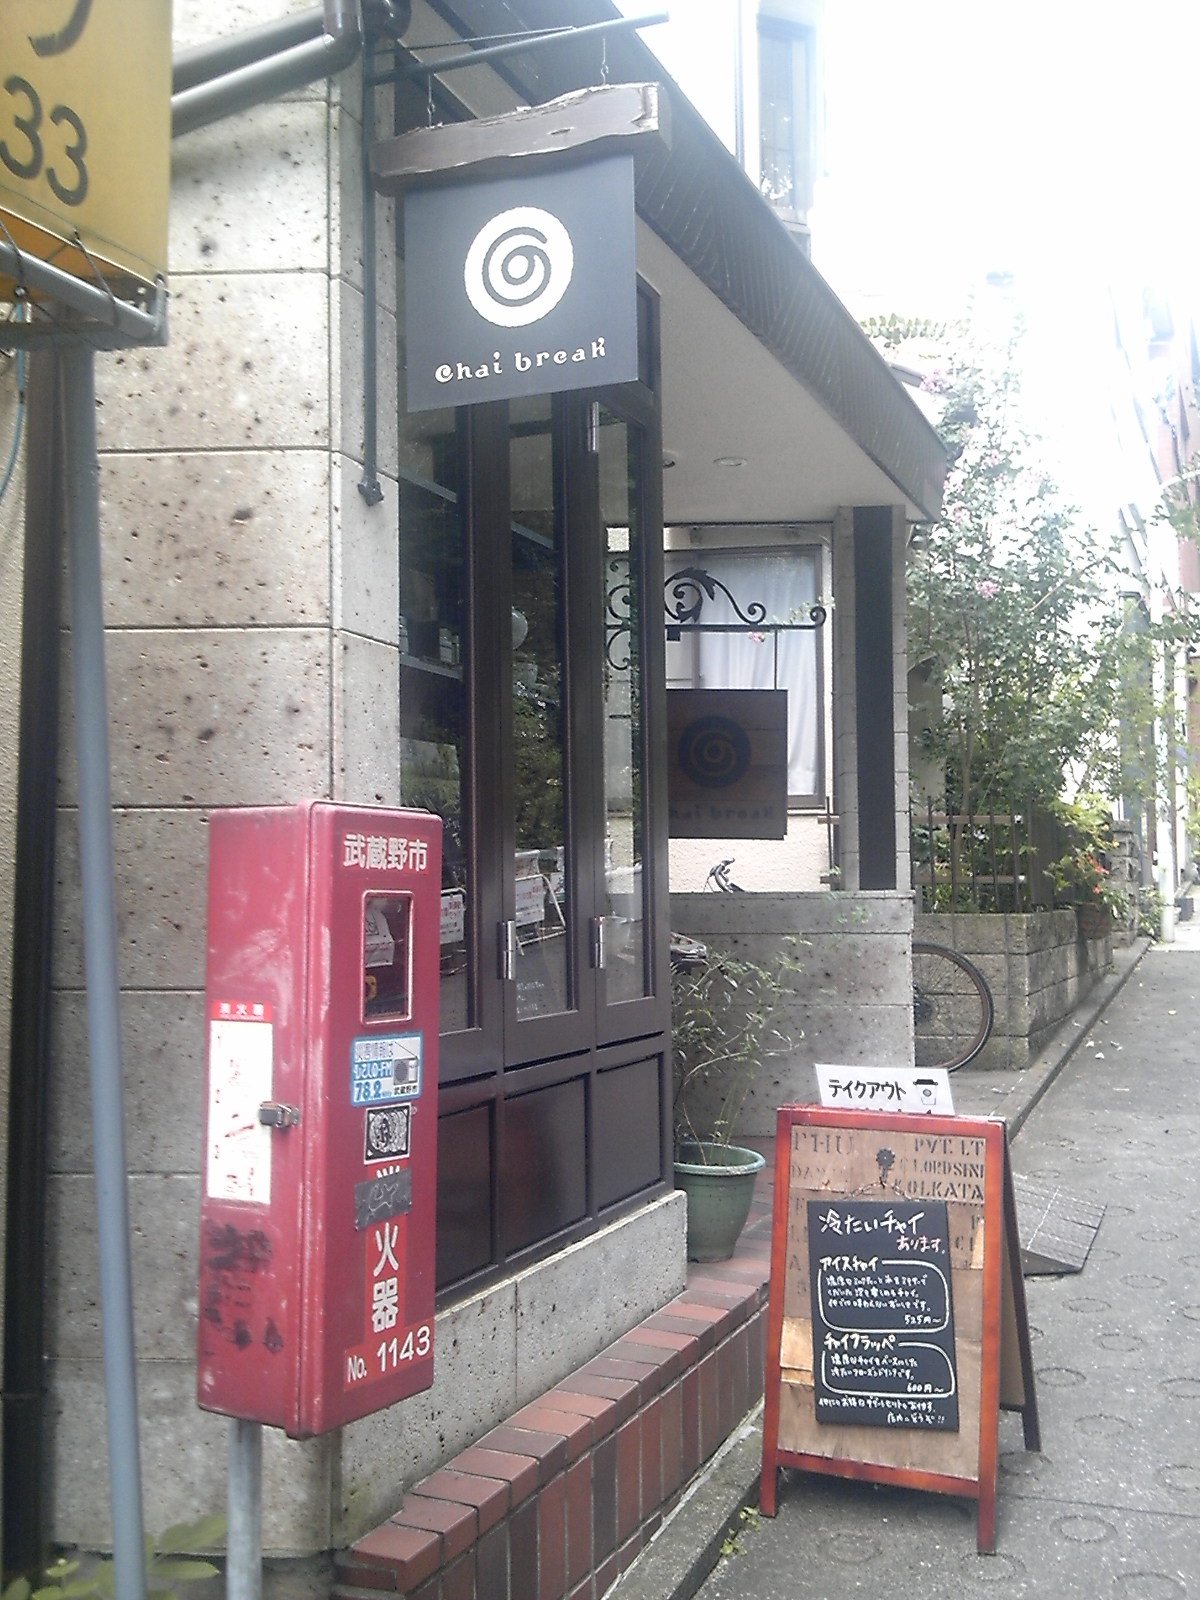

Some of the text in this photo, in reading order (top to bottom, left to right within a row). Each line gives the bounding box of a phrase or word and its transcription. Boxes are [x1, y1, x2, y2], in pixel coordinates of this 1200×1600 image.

[514, 336, 607, 372] break
[343, 833, 428, 871] 武蔵野市
[355, 1080, 382, 1101] 78.2
[828, 1078, 907, 1101] テイクアウト
[818, 1208, 926, 1236] 冷たいチャイ
[371, 1166, 402, 1334] 火器
[819, 1255, 880, 1272] アイスチャイ
[347, 1325, 431, 1383] No. 1143
[823, 1332, 896, 1351] チャイフラッペ
